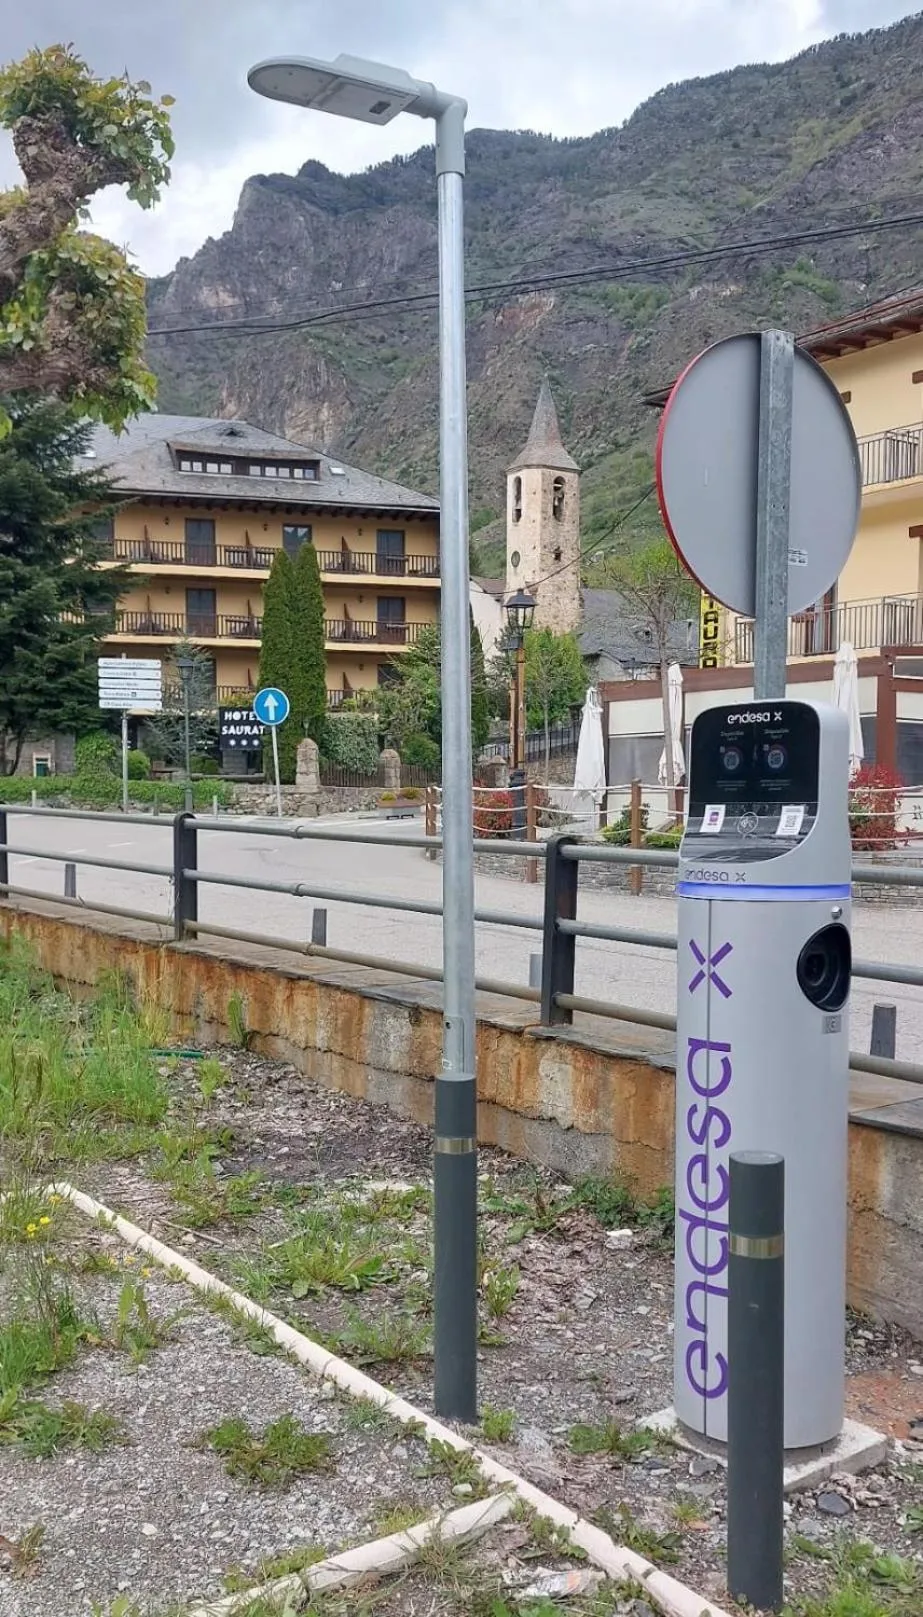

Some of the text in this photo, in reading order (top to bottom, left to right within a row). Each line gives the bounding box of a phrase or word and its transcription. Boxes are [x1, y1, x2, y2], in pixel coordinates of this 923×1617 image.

[224, 711, 258, 720] HOTE
[727, 711, 770, 724] endesa
[221, 725, 265, 735] SAURAT
[685, 869, 729, 881] endesa
[679, 1037, 732, 1399] endesa
